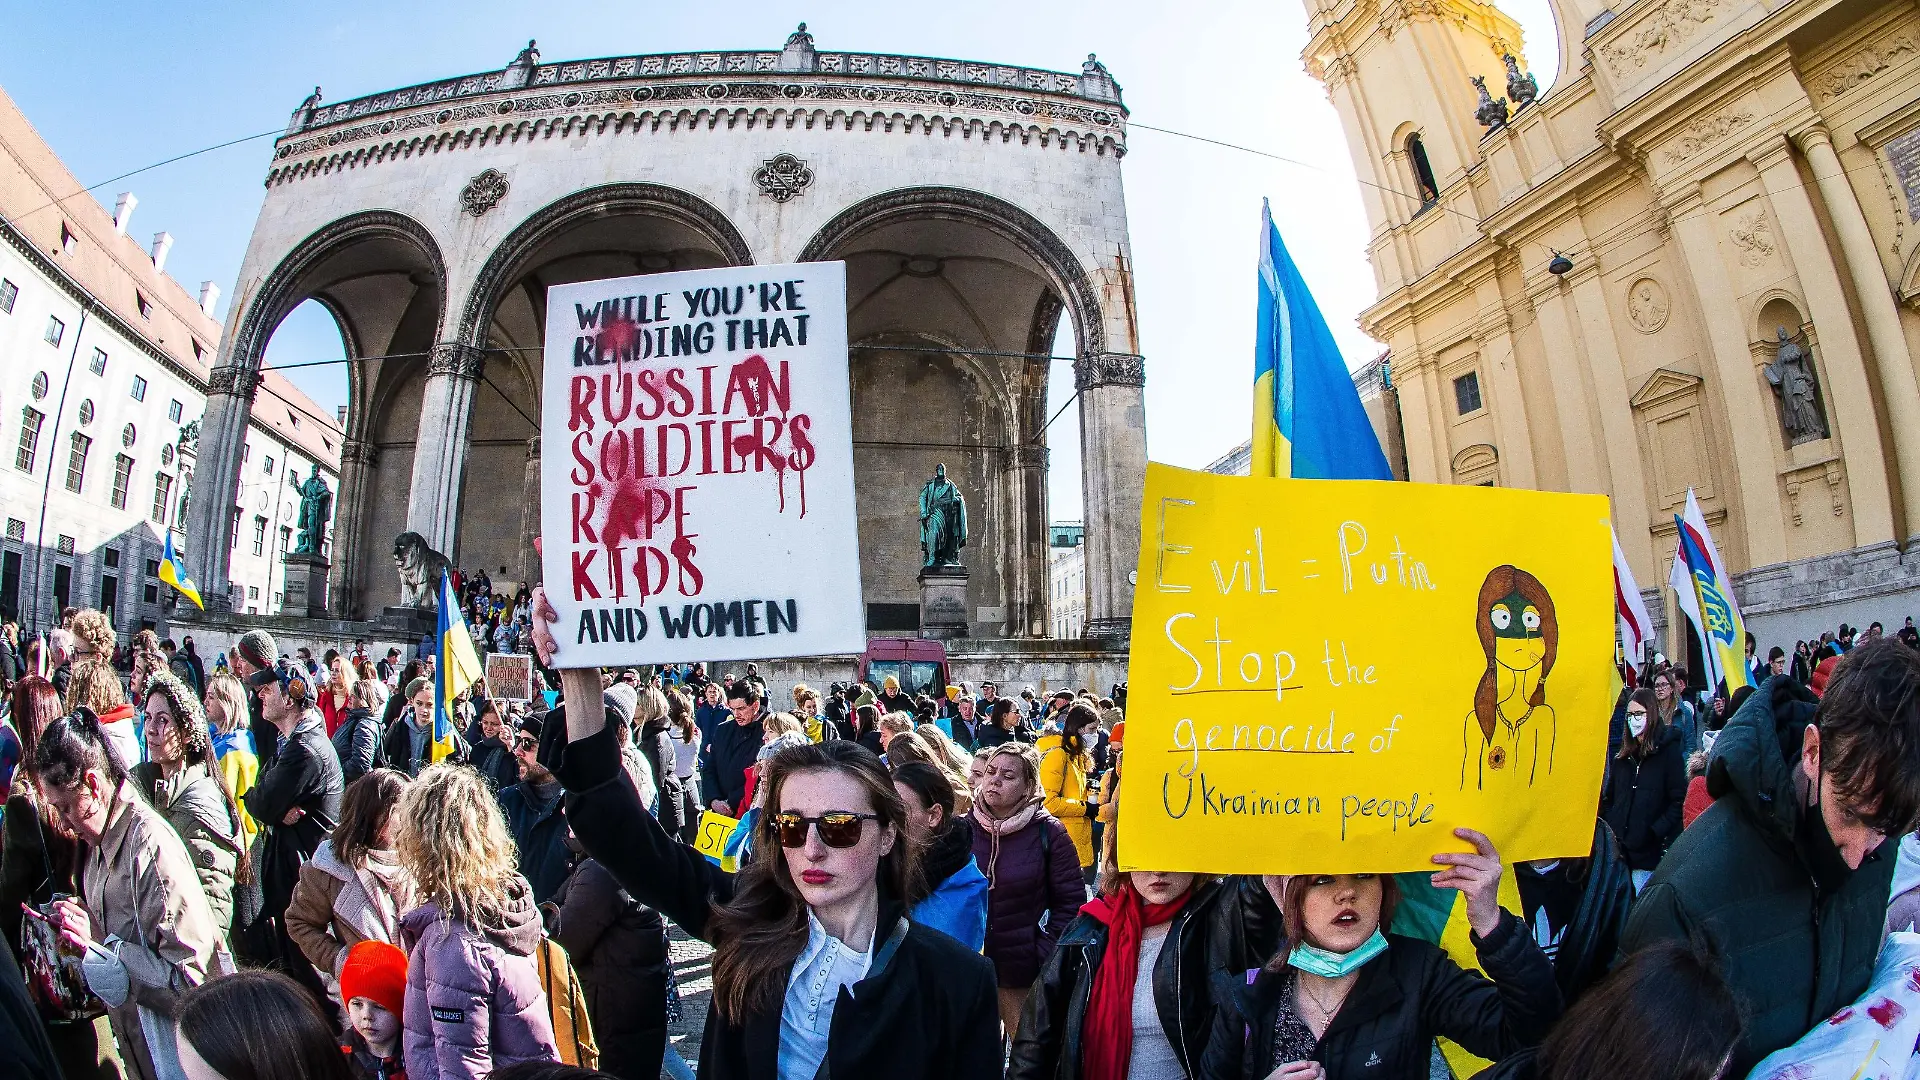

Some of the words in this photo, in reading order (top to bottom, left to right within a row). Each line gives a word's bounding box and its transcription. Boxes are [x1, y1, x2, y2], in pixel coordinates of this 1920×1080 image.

[575, 292, 671, 331] WHILE
[683, 279, 807, 318] YOU'RE
[725, 314, 811, 352] THAT
[568, 354, 791, 431] RUSSIAN
[570, 413, 816, 486] SOLDIERS
[571, 485, 699, 546] RAPE
[571, 545, 704, 603] KIDS
[1338, 520, 1436, 594] Putin
[577, 607, 648, 644] AND
[658, 598, 798, 640] WOMEN
[1164, 612, 1296, 702] Stop
[1321, 639, 1378, 687] the
[1172, 710, 1356, 778] genocide
[1369, 714, 1403, 753] of
[1163, 772, 1321, 819] Ukrainian
[1341, 791, 1436, 841] people
